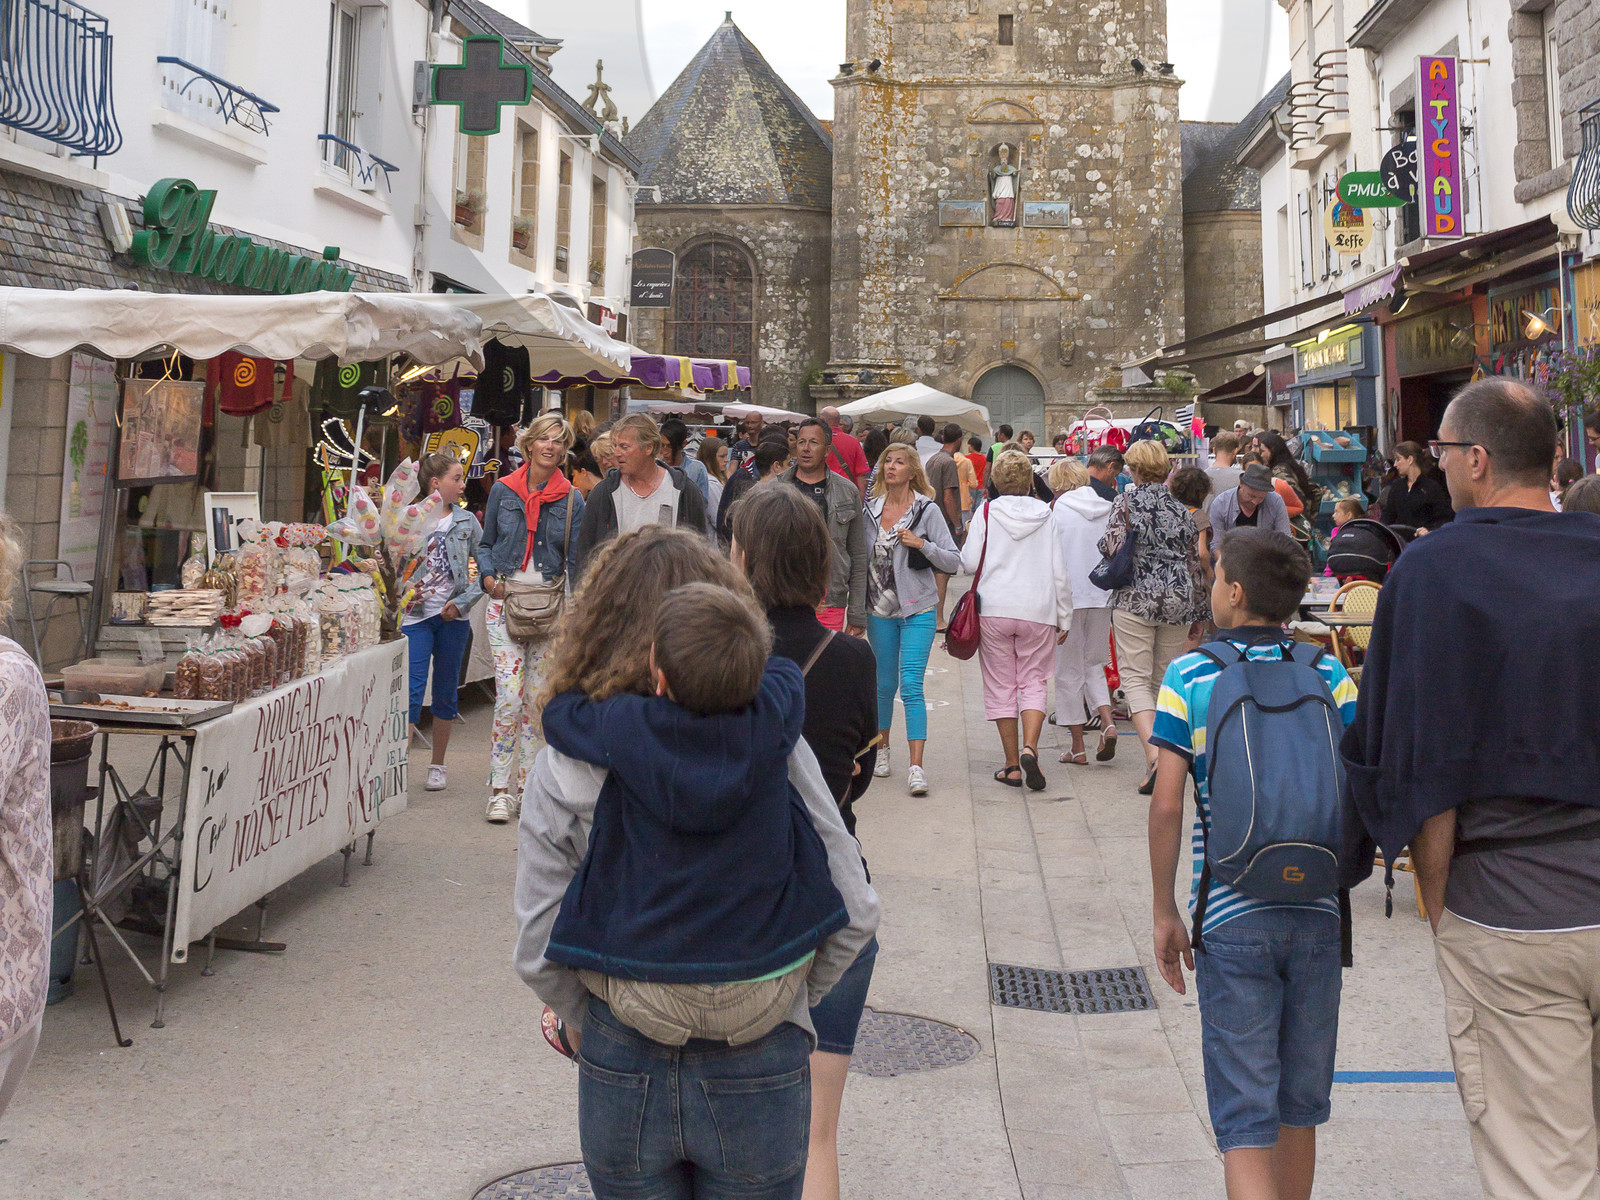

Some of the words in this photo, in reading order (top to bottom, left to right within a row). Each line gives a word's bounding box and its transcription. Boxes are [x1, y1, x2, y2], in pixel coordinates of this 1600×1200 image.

[1347, 183, 1379, 197] PMU
[1429, 60, 1455, 233] ARTYCHAUD
[132, 177, 356, 294] Pharmacie
[1334, 233, 1364, 249] Leffe
[252, 712, 342, 805] AMANDES
[253, 676, 325, 753] NOUGAT
[229, 767, 332, 873] NOISETTES
